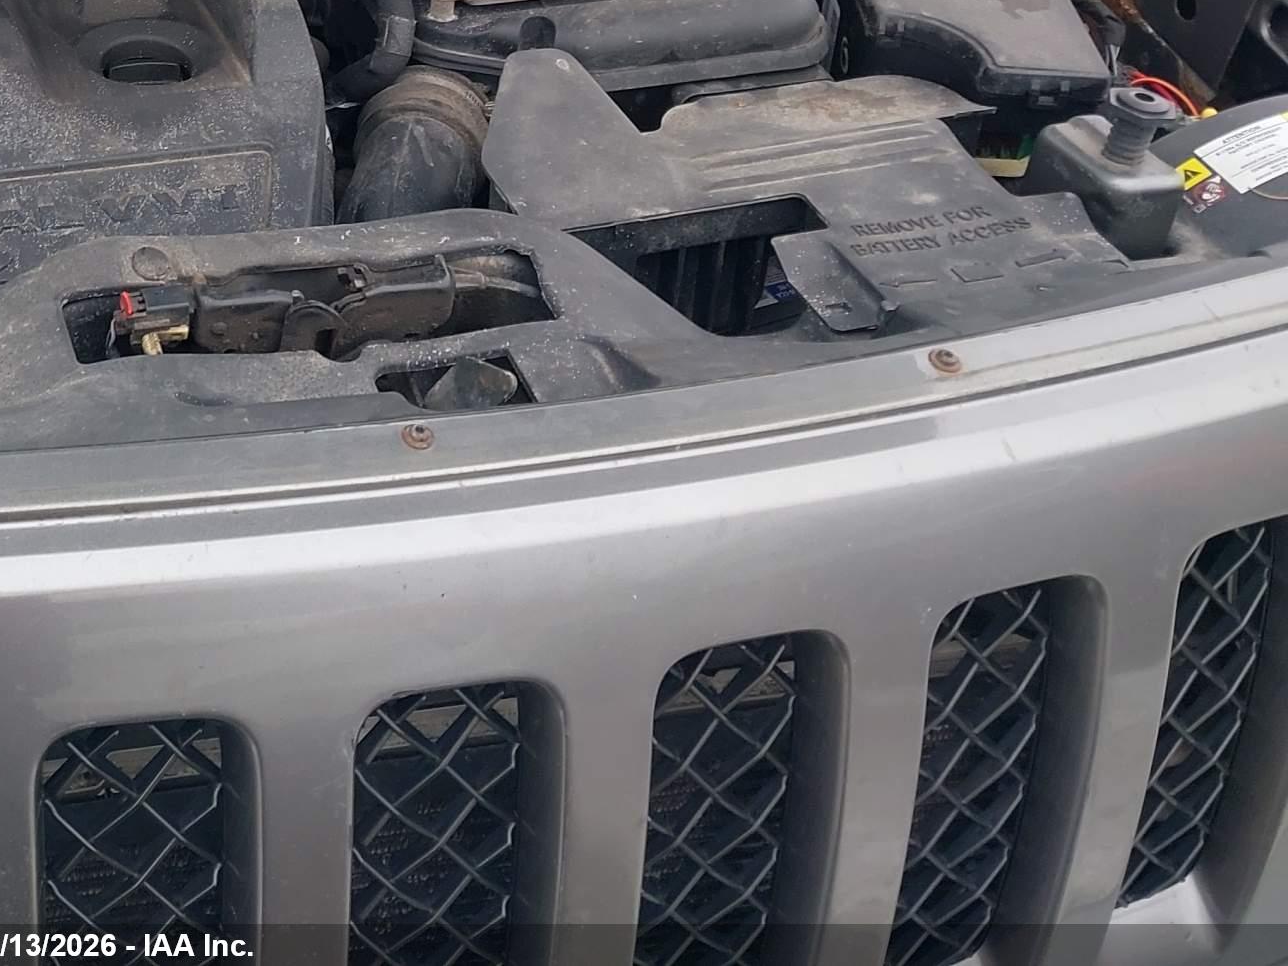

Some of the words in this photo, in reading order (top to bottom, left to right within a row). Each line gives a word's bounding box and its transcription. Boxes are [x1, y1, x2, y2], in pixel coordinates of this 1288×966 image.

[850, 215, 944, 238] REMOVE
[942, 205, 992, 223] FOR
[850, 235, 942, 257] BATTERY
[948, 217, 1033, 247] ACCESS
